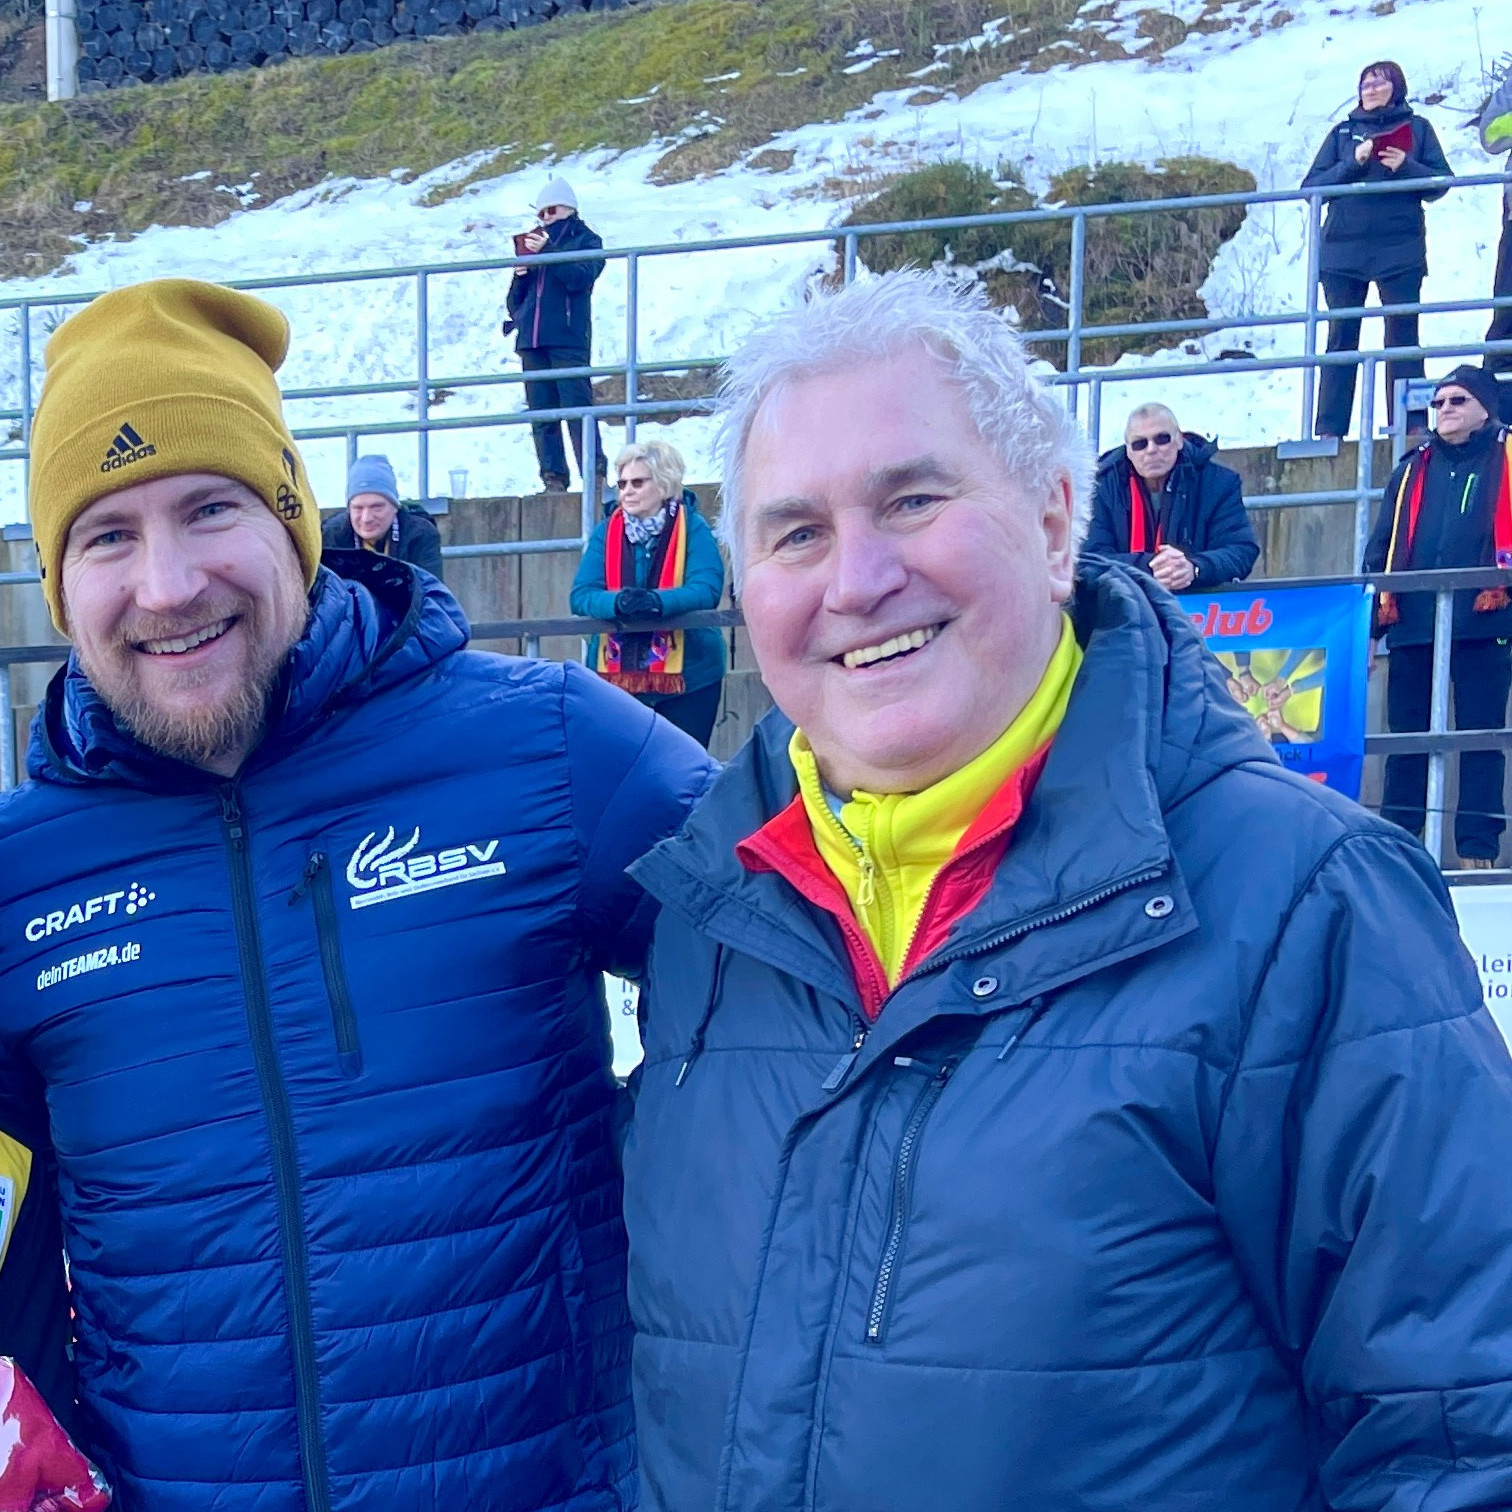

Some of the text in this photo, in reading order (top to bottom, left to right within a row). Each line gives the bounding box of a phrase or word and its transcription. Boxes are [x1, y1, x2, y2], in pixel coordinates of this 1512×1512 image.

[101, 444, 157, 472] adidas
[378, 839, 500, 886] RBSV
[25, 890, 125, 942] CRAFT
[37, 941, 141, 991] deinTEAM24.de
[1488, 979, 1512, 999] io
